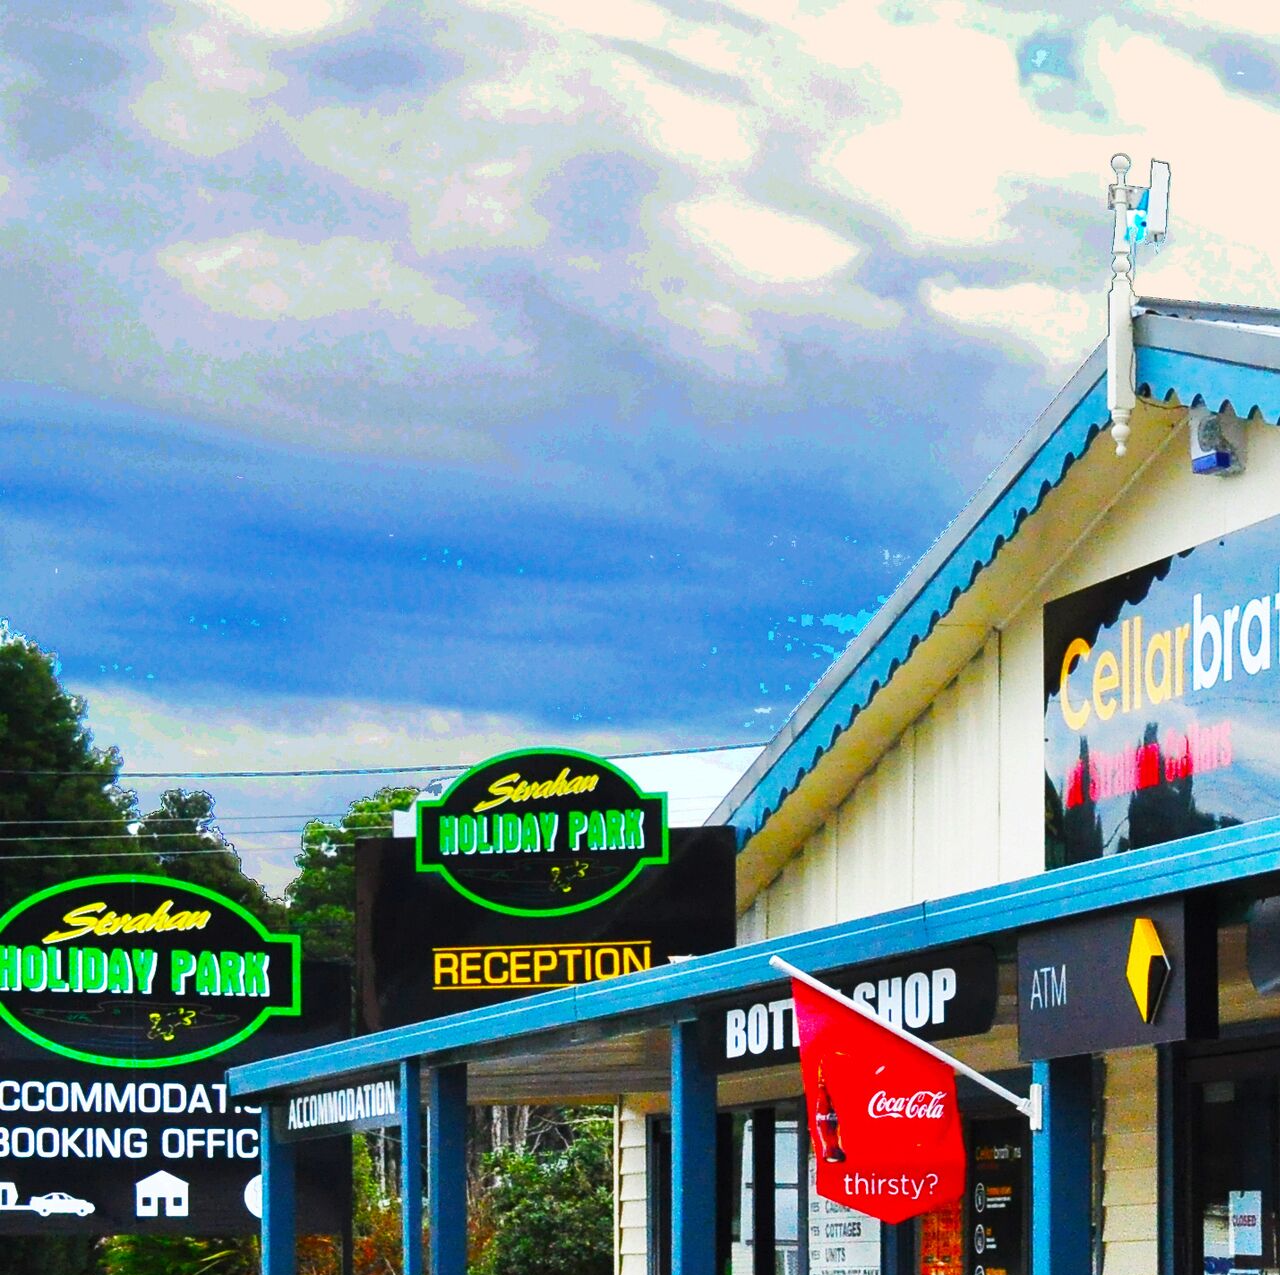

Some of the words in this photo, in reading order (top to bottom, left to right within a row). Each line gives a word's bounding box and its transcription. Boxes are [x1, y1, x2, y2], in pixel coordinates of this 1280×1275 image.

[472, 766, 600, 813] Strahan
[439, 811, 559, 856] HOLIDAY
[568, 808, 645, 852] PARK
[41, 900, 212, 944] Strahan
[0, 944, 158, 995] HOLIDAY
[170, 949, 270, 998] PARK
[433, 946, 652, 985] RECEPTION
[853, 968, 957, 1029] SHOP
[1029, 964, 1067, 1011] ATM
[287, 1080, 396, 1131] ACCOMMODATION
[867, 1090, 948, 1119] Coca-Cola
[161, 1127, 260, 1159] OFFIC
[843, 1173, 939, 1200] thirsty?
[825, 1221, 862, 1239] COTTAGES
[1232, 1213, 1257, 1228] CLOSED
[825, 1247, 846, 1263] UNITS
